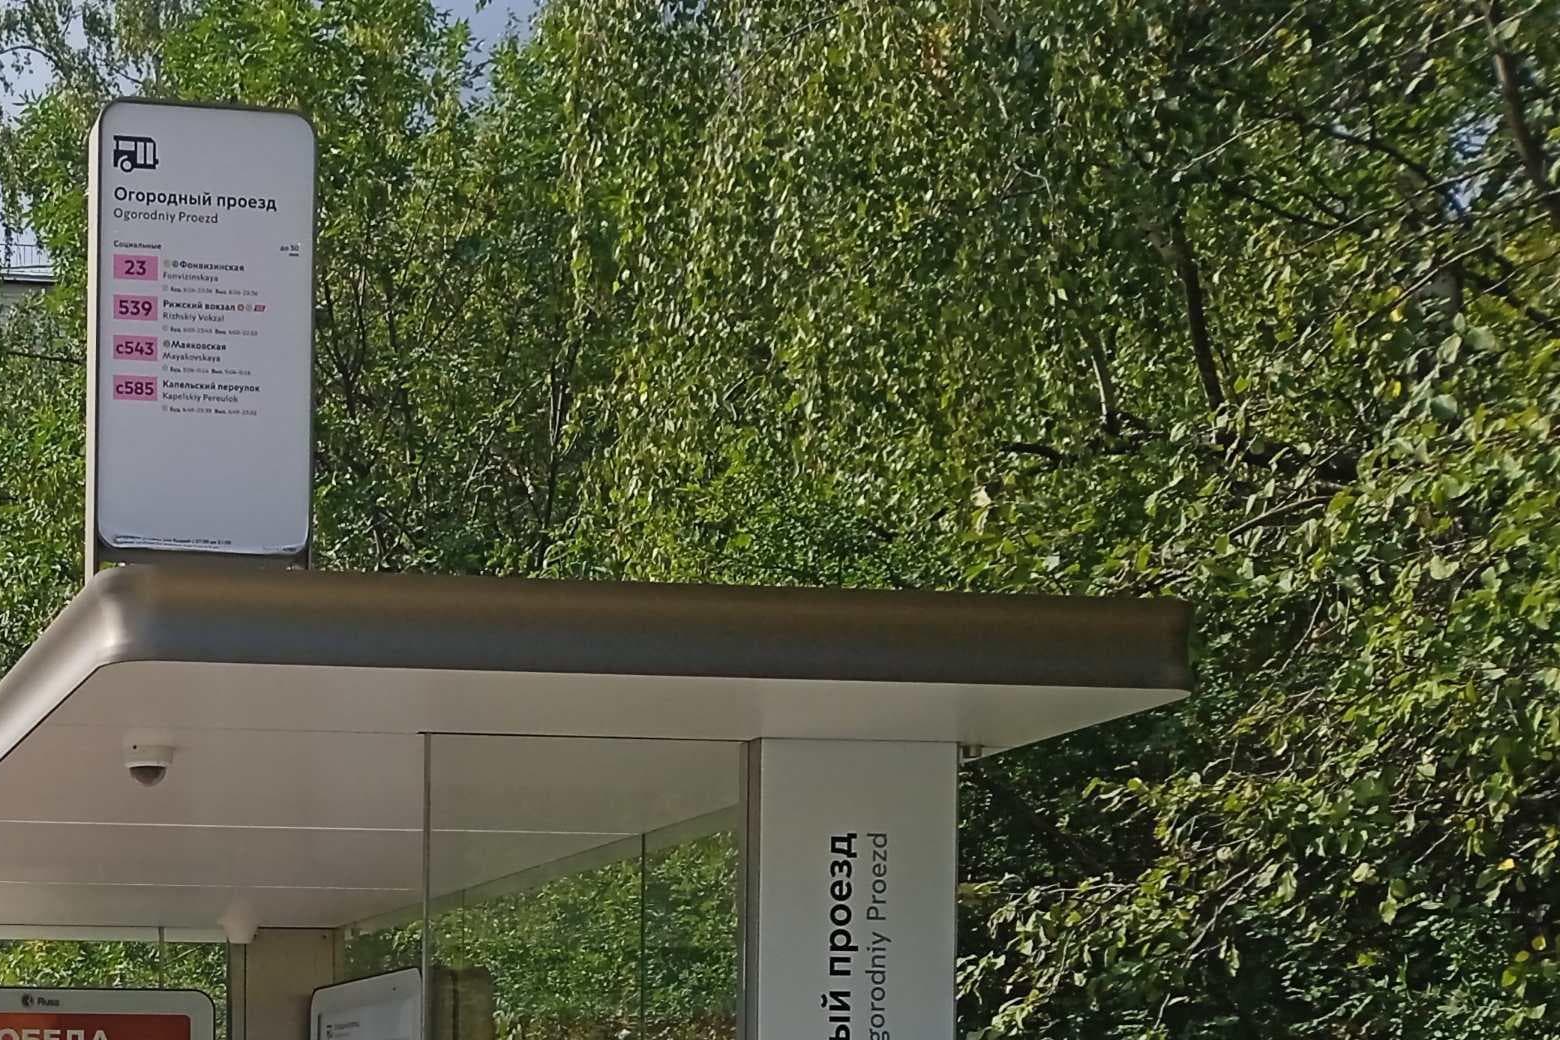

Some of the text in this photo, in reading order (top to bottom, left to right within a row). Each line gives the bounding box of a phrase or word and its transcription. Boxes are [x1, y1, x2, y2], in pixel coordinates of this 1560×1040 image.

[114, 186, 277, 212] Огородный проезд
[113, 207, 219, 224] Ogorodniy Proezd
[124, 260, 147, 276] 23
[119, 300, 153, 316] 539
[163, 299, 203, 309] Рижский
[171, 340, 227, 351] Маяковская
[162, 380, 261, 393] Капельский переулок
[866, 832, 888, 921] Proezd
[828, 833, 859, 977] проезд
